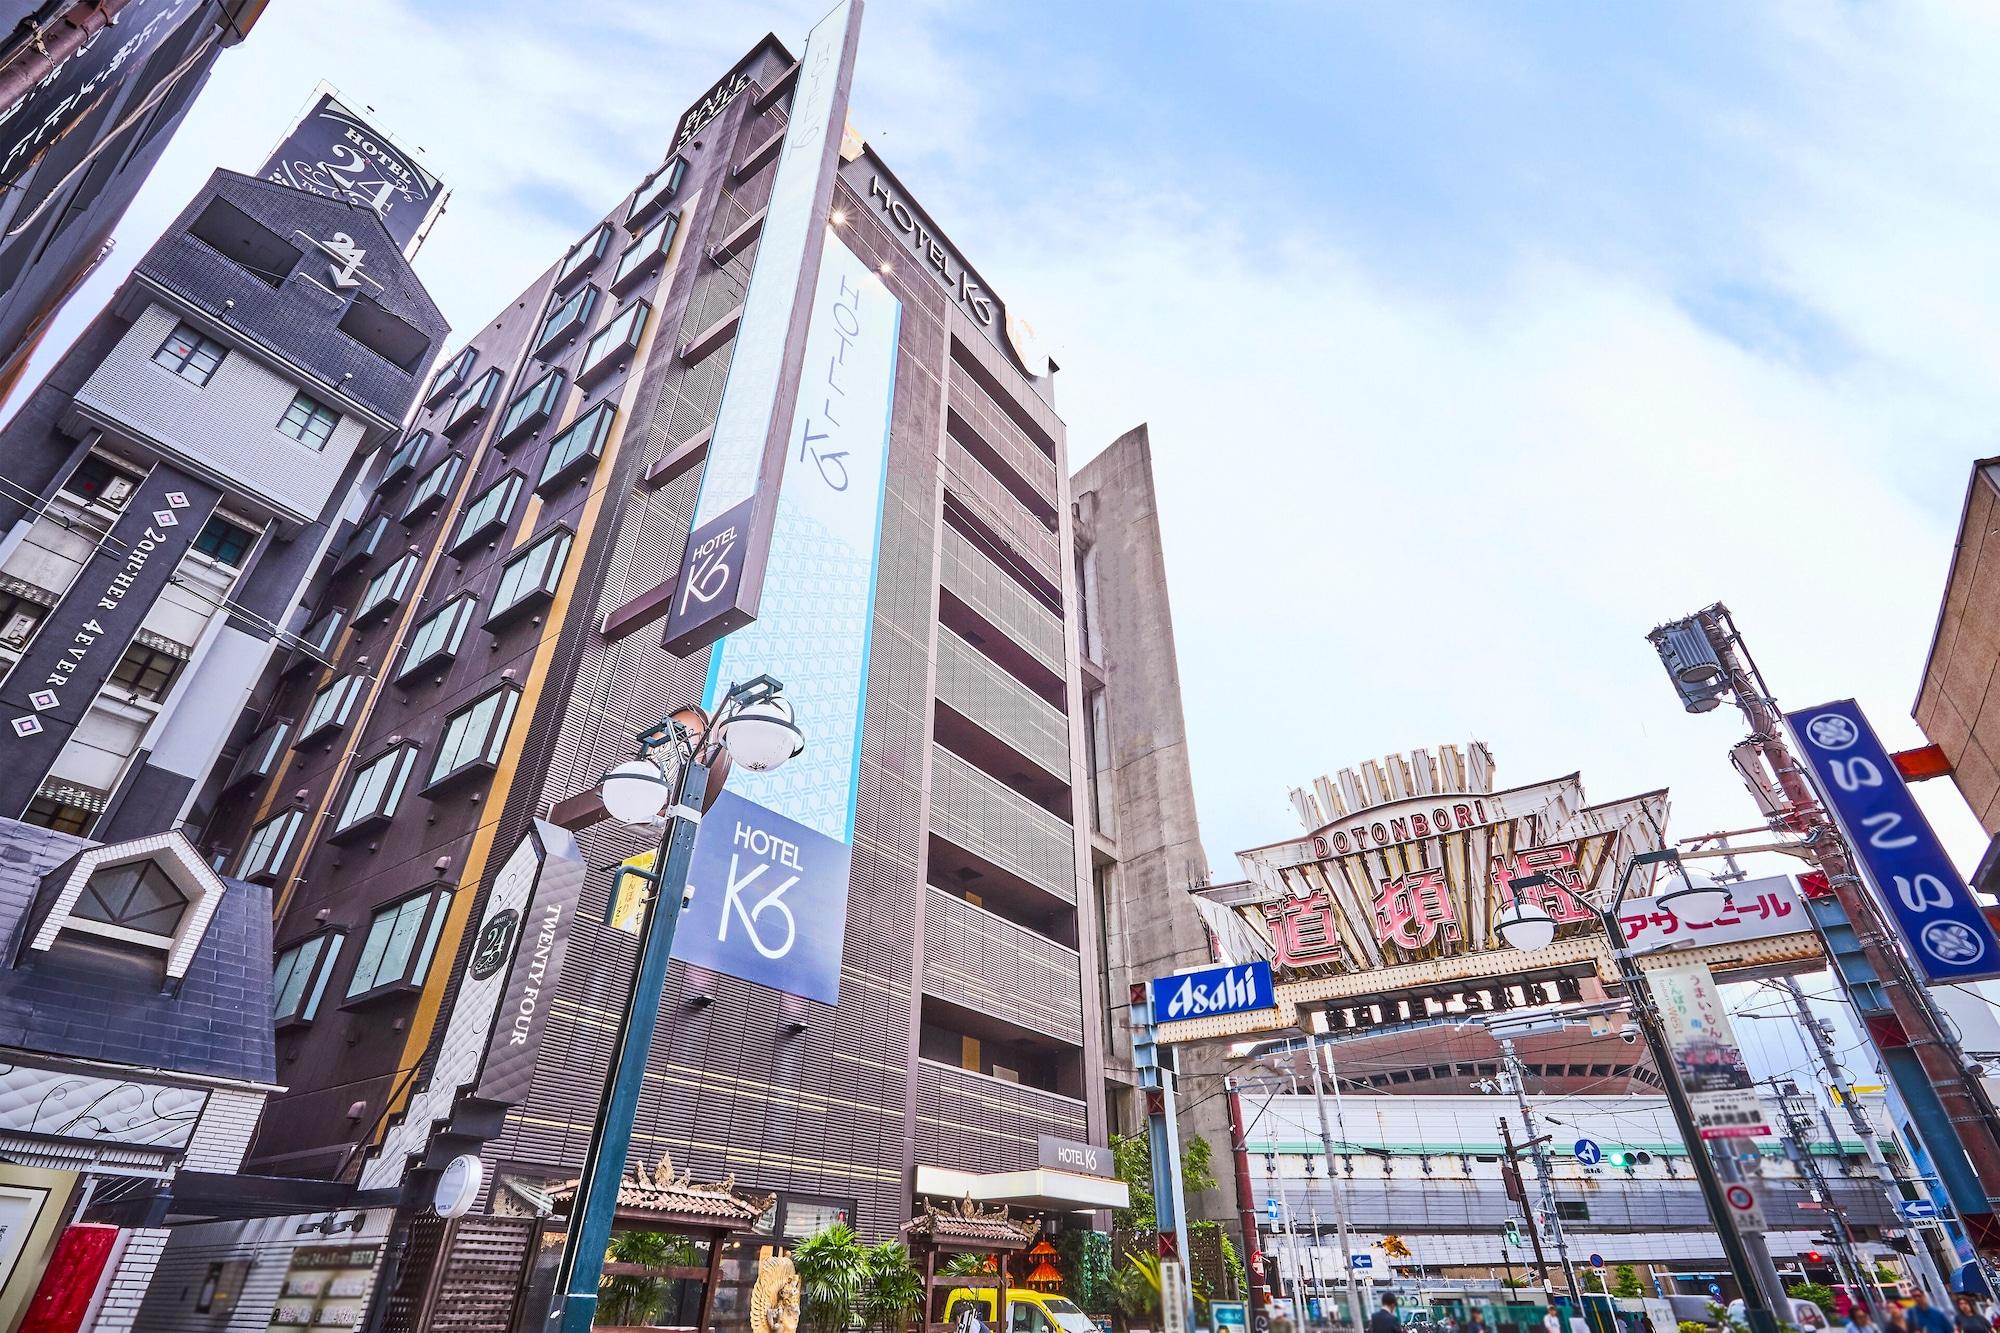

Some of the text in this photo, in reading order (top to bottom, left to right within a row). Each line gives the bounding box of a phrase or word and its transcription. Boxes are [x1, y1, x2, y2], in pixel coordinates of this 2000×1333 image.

[678, 74, 748, 144] STYLE
[684, 73, 736, 130] BALI
[316, 144, 397, 212] 24
[344, 127, 413, 186] HOTEL
[871, 175, 993, 325] HOTEL K6
[800, 418, 850, 492] K6
[692, 526, 738, 562] HOTEL
[679, 542, 736, 616] K6
[46, 619, 104, 686] 4EVER
[734, 821, 804, 872] HOTEL
[1314, 800, 1487, 859] DOTONBORI
[717, 852, 802, 961] K6
[510, 905, 562, 1045] TWENTY FOUR
[1168, 966, 1257, 1018] Asahi
[1689, 974, 1722, 1039] うまいもん
[1058, 1147, 1097, 1171] HOTEL K6
